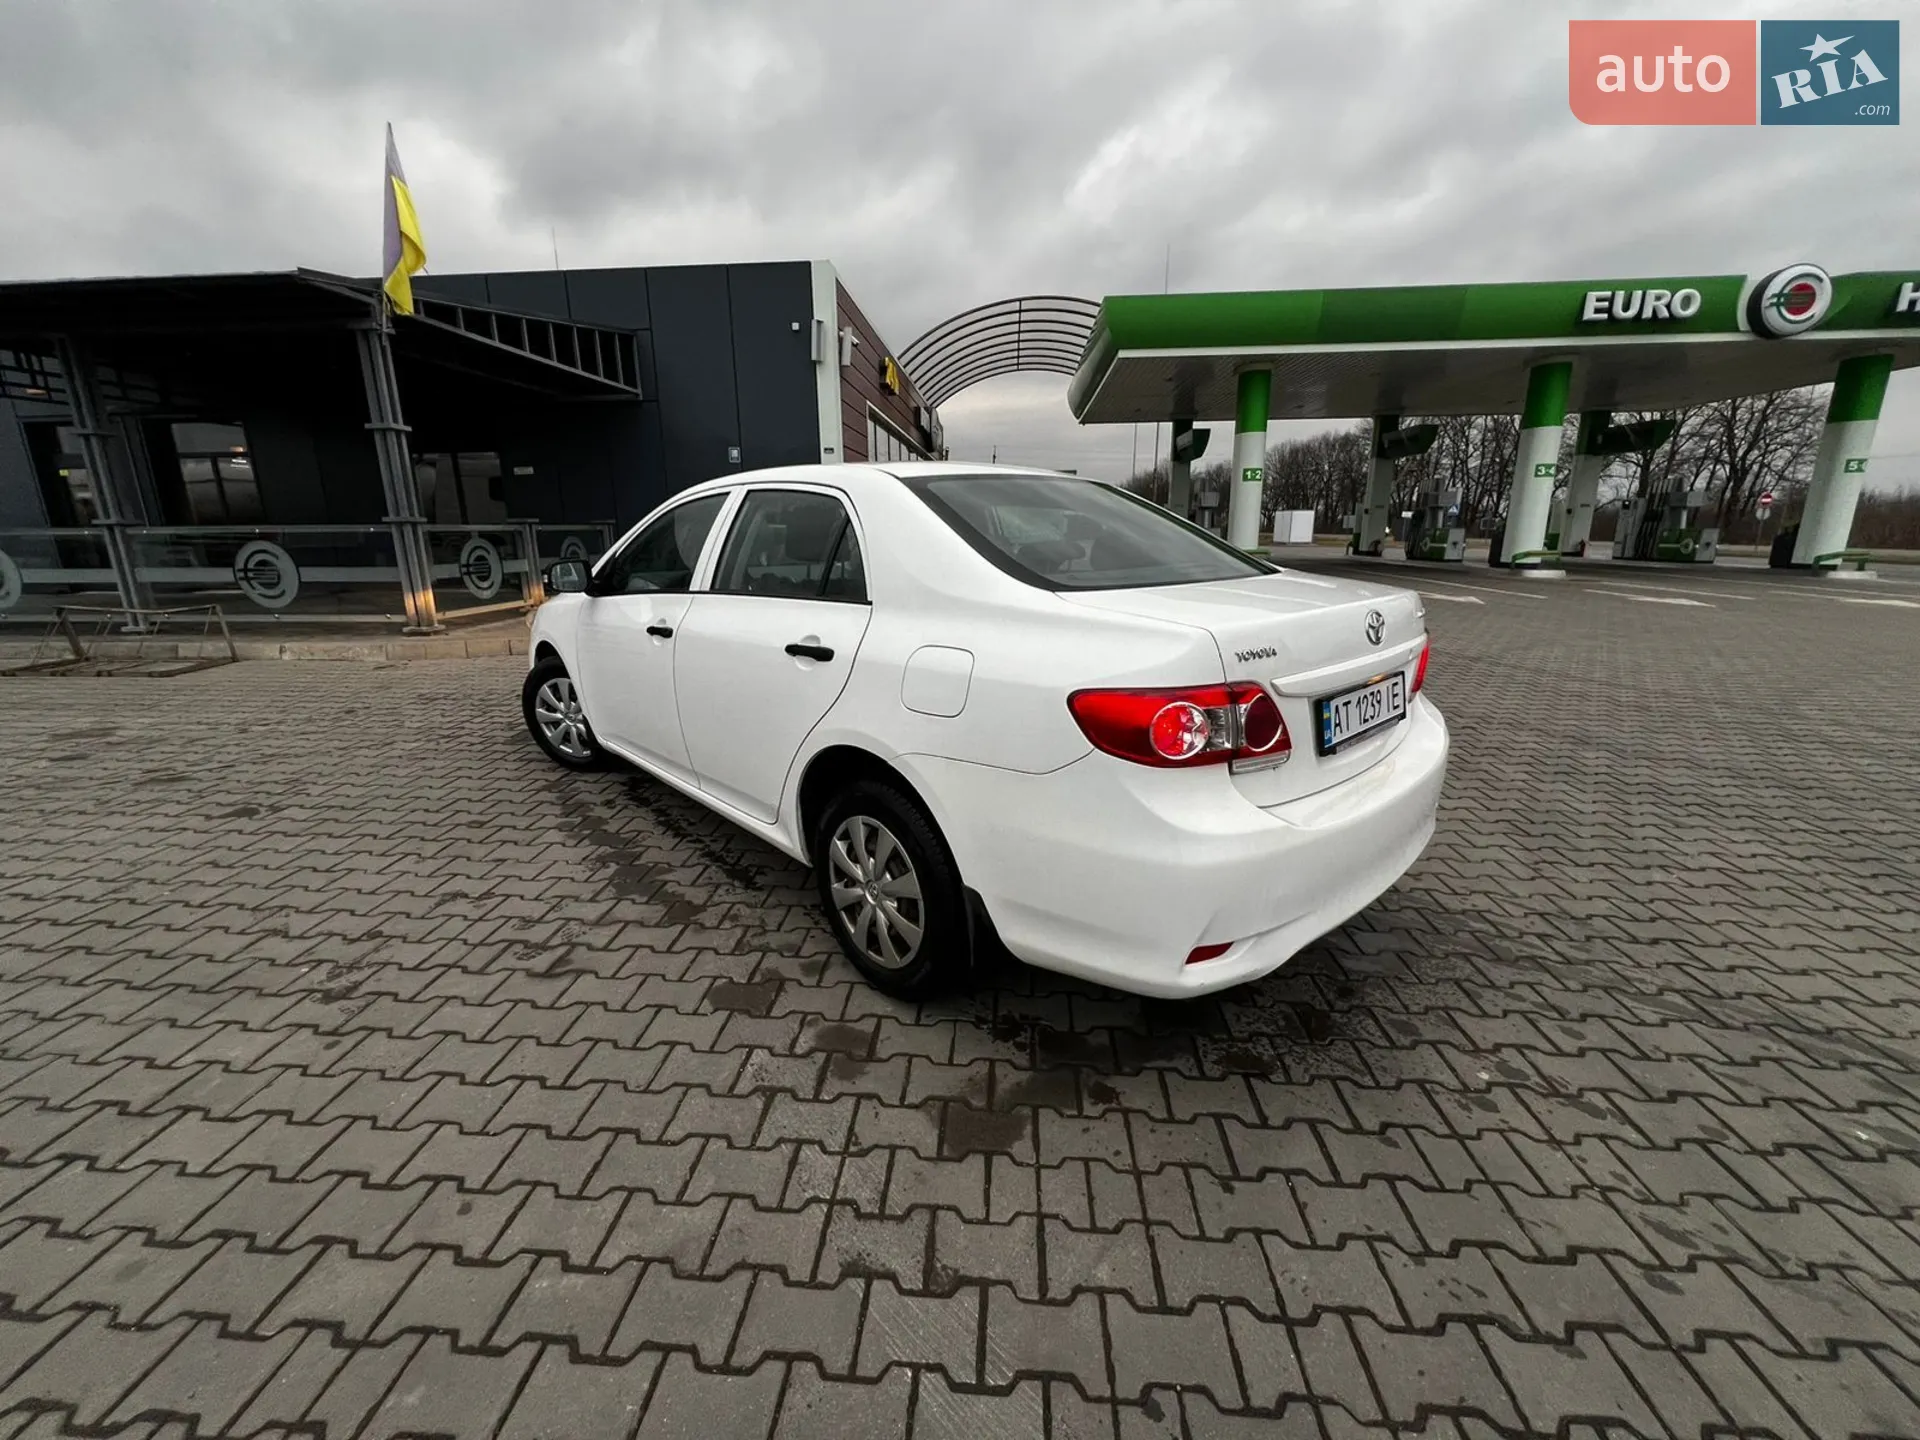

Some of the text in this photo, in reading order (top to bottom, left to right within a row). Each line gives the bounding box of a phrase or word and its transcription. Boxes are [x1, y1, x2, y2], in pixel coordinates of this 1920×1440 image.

[1582, 287, 1702, 321] EURO
[1234, 645, 1278, 663] TOYOTA
[1333, 700, 1352, 737] AT
[1355, 689, 1382, 726] 1239
[1386, 681, 1400, 713] IE
